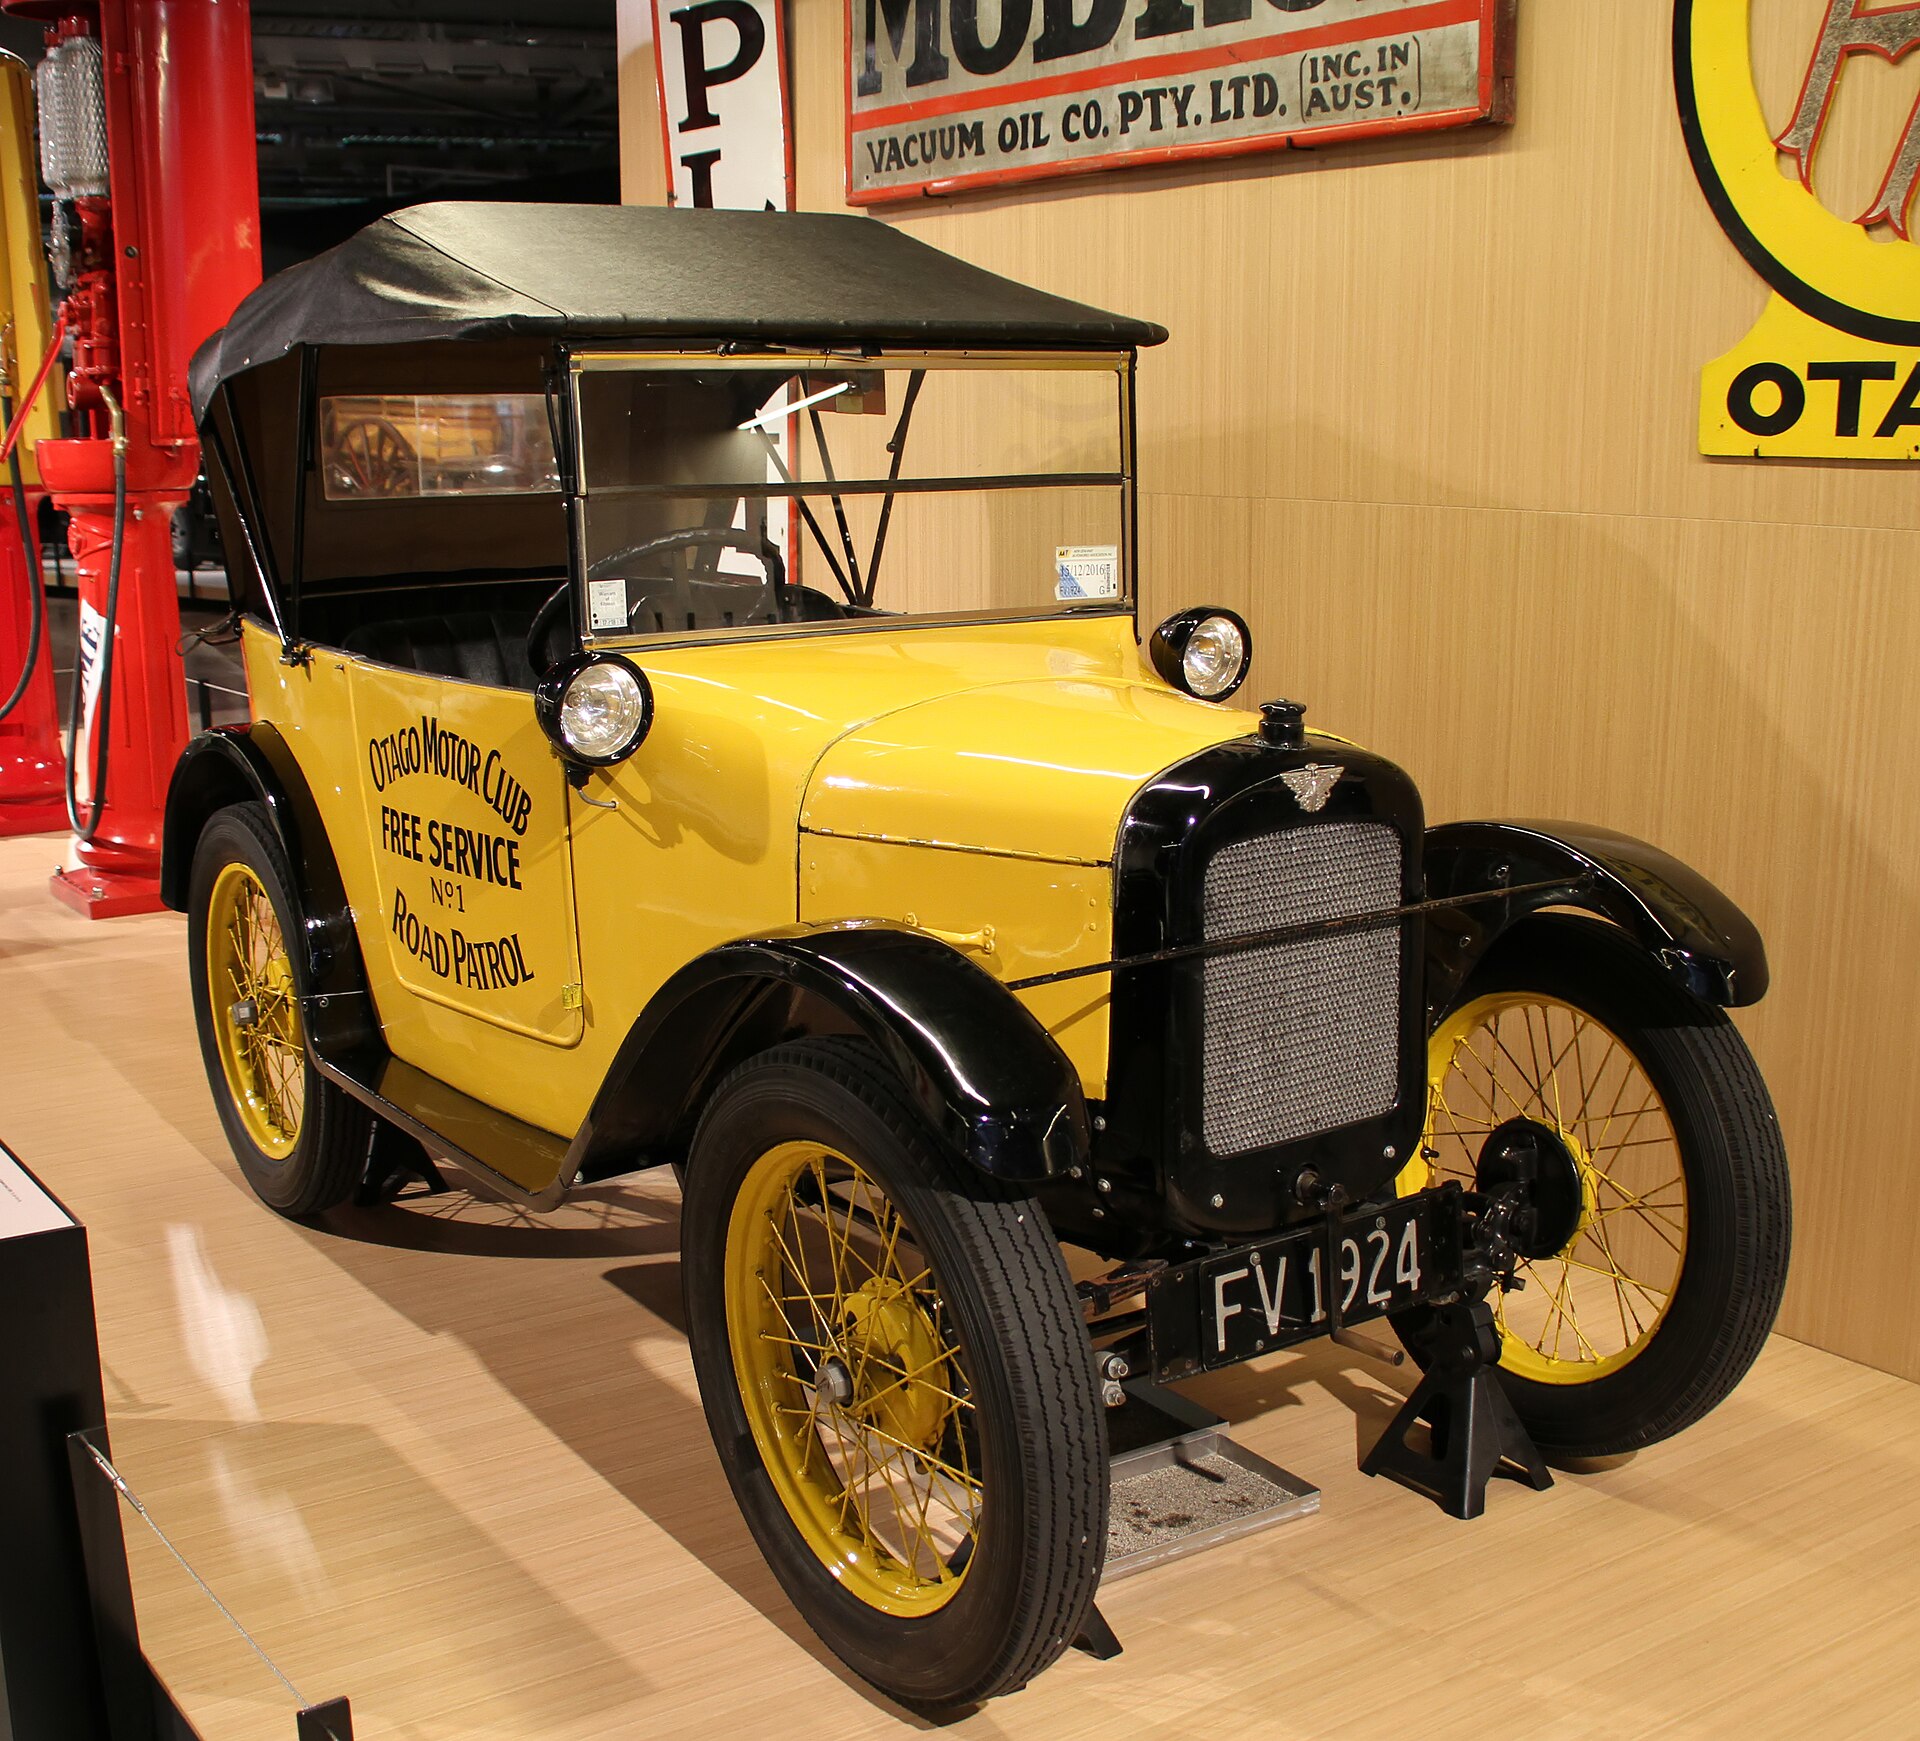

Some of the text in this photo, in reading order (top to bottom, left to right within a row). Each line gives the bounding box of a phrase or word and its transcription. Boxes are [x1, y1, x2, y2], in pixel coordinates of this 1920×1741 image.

[867, 72, 1287, 173] VACUUM OIL CO. PTY. LTD.
[369, 716, 532, 836] OTAGO MOTOR CLUB
[382, 805, 522, 890] FREE SERVICE
[392, 887, 535, 990] ROAD PATROL
